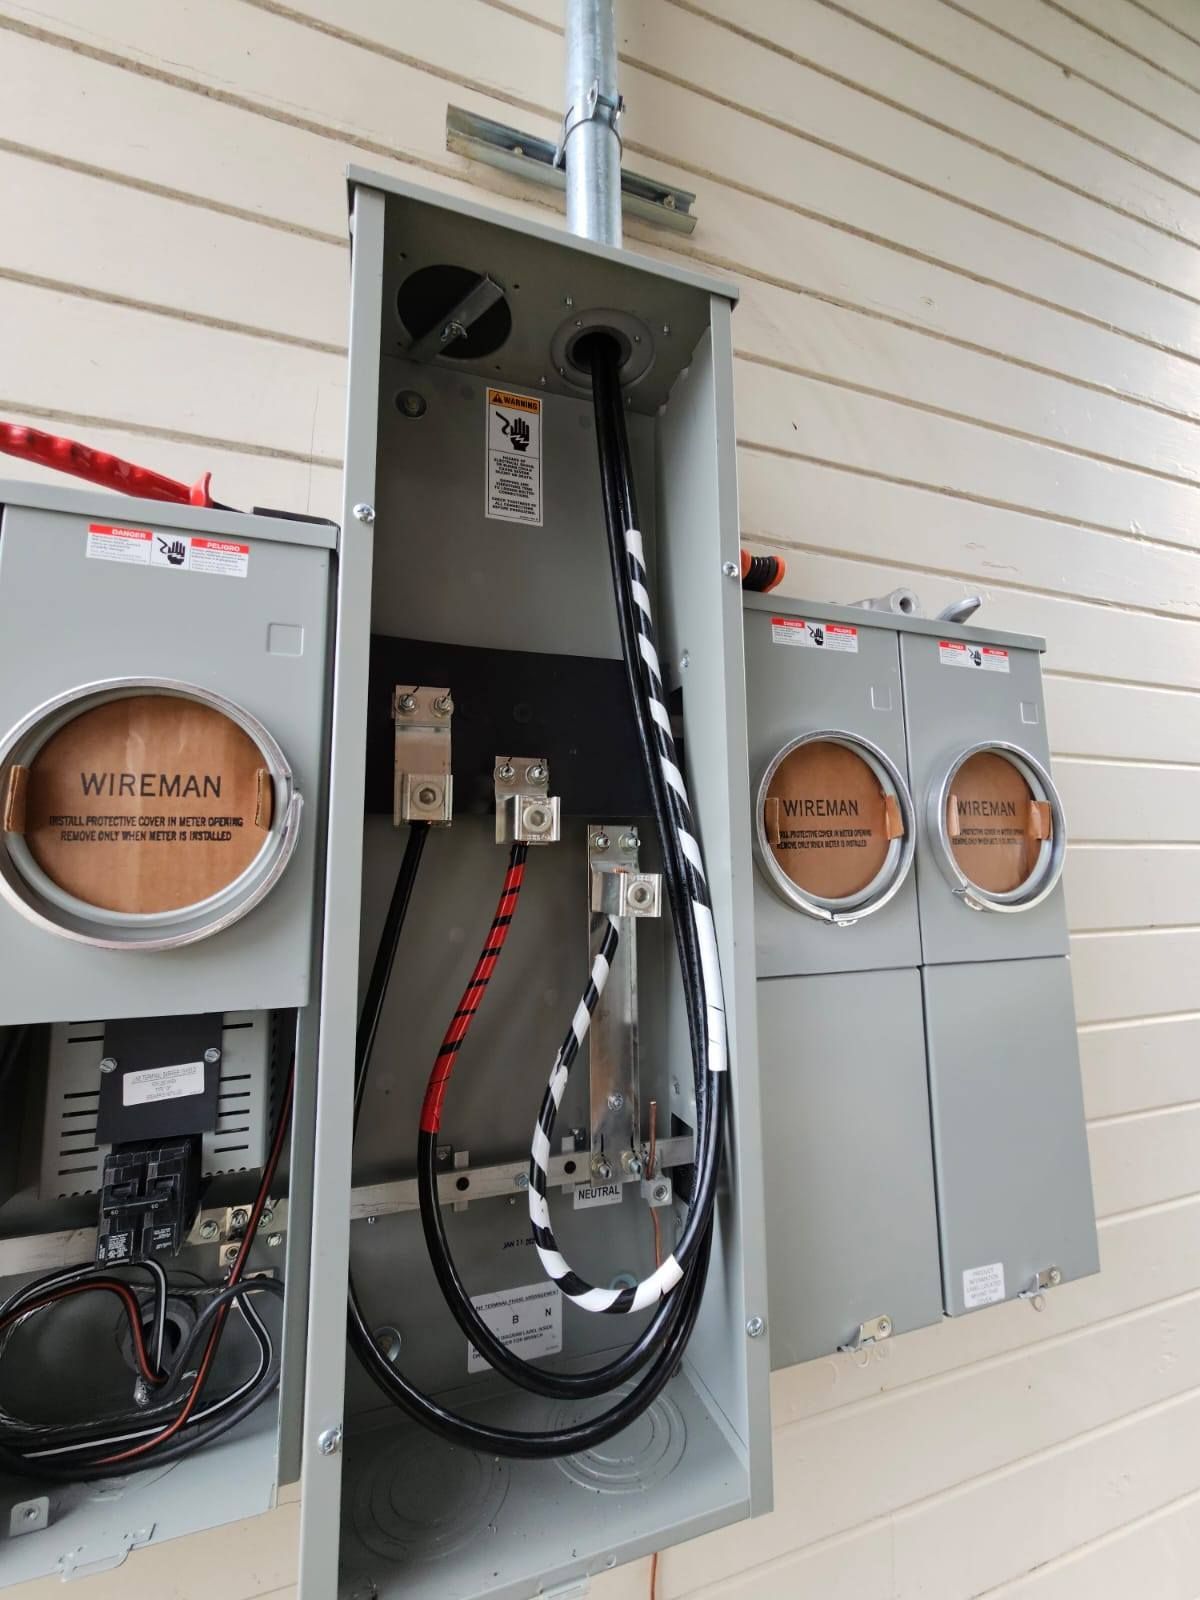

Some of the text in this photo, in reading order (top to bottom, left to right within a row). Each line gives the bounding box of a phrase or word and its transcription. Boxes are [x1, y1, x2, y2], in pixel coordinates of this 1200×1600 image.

[503, 396, 537, 410] WARNING
[112, 528, 146, 539] DANGER
[207, 542, 240, 552] PELIGRO
[80, 772, 222, 798] WIREMAN
[782, 799, 860, 816] WIREMAN
[957, 801, 1016, 816] WIREMAN
[49, 816, 243, 827] INSTALL PROTECTIVE COVER IN METER OPENING
[61, 831, 232, 841] REMOVE ONLY WHEN METER IS INSTALLED
[578, 1185, 620, 1200] NEUTRAL
[502, 1239, 514, 1248] JAN
[512, 1308, 552, 1324] B N
